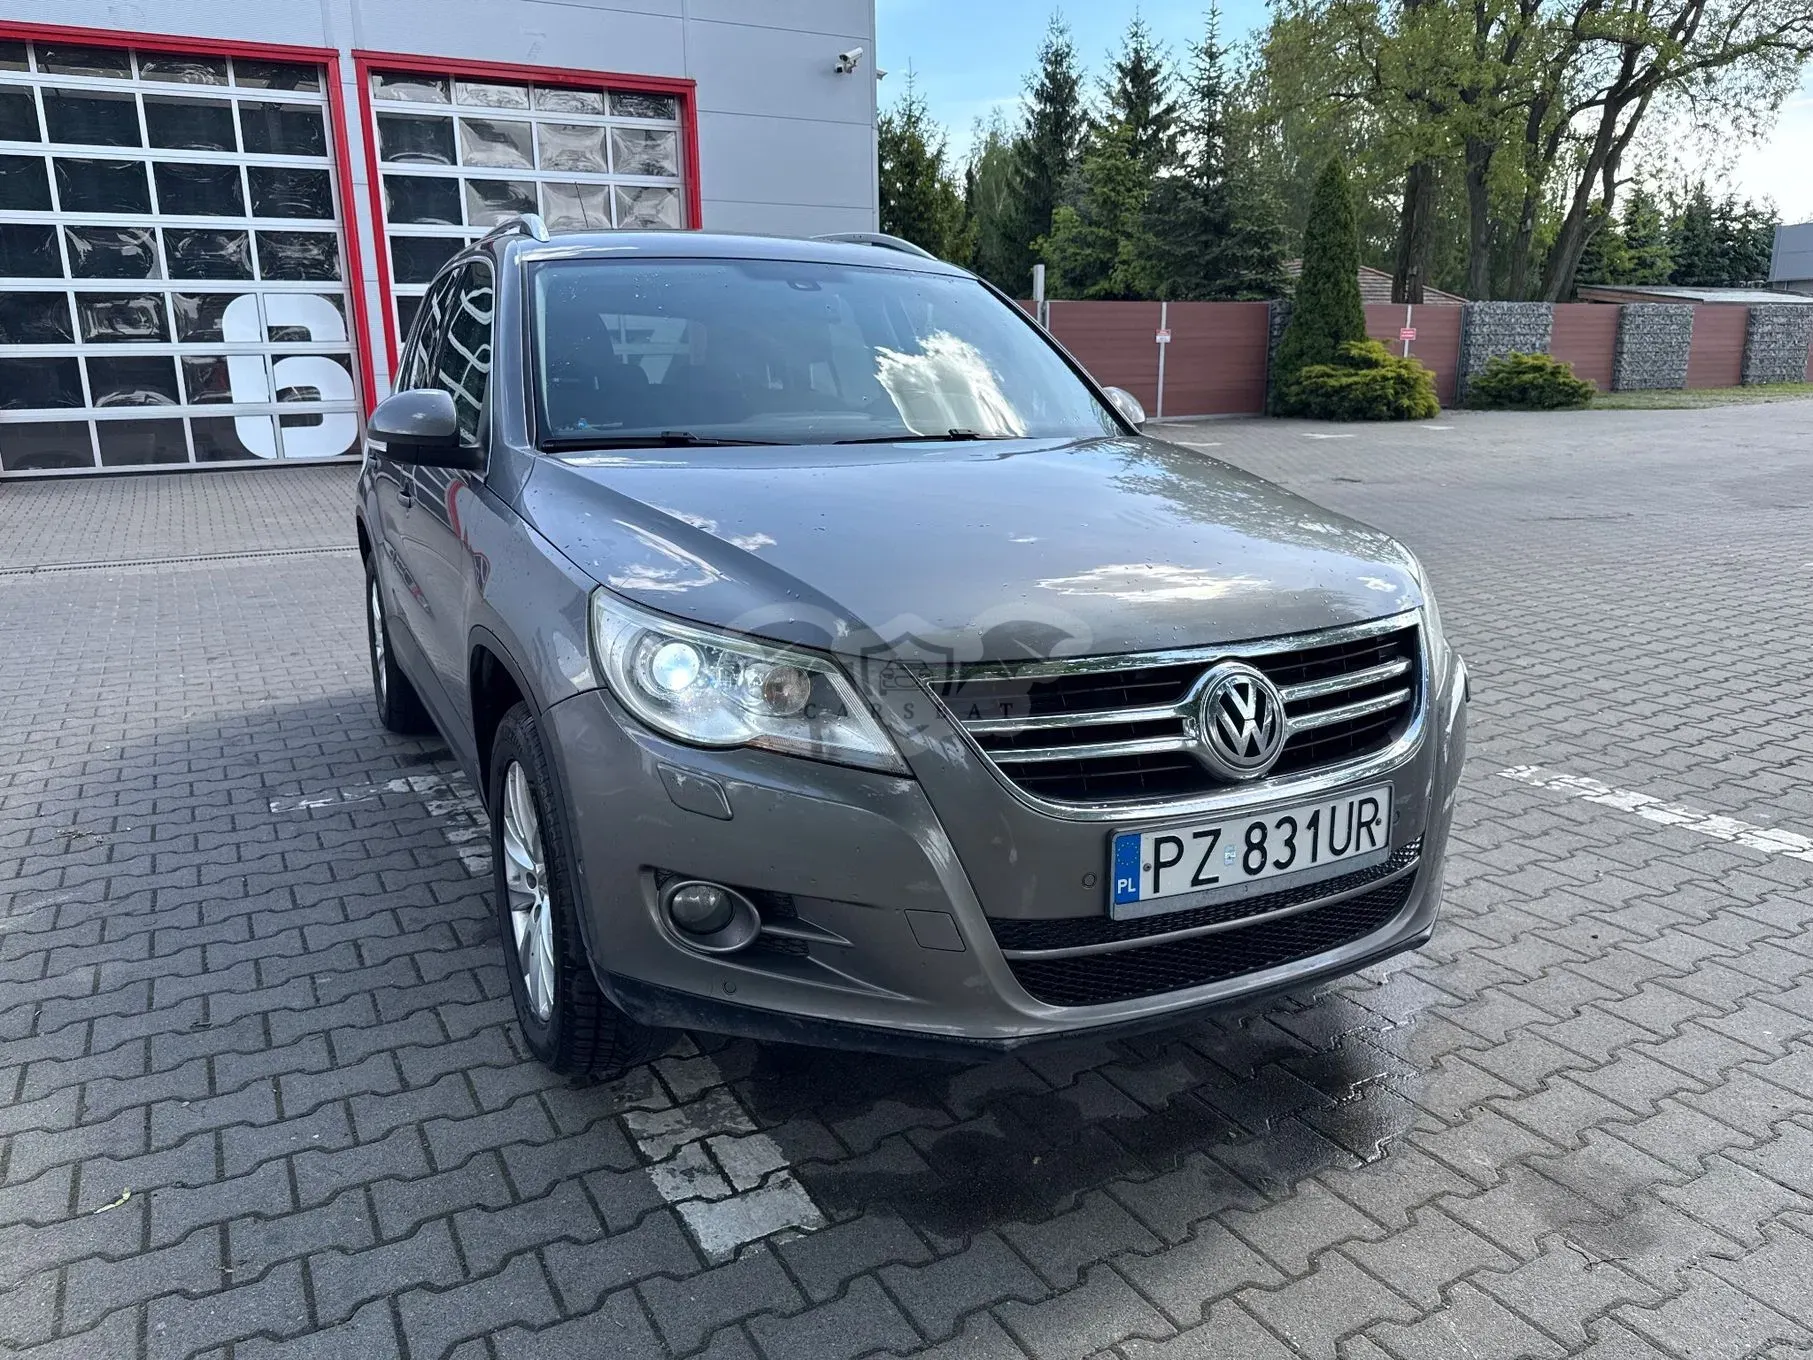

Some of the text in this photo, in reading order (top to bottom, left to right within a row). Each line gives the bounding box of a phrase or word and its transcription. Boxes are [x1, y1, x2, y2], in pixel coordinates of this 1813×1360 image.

[222, 293, 359, 459] 6
[1208, 672, 1280, 767] VW
[1117, 877, 1136, 894] PL
[1153, 797, 1378, 894] PZ 831UR
